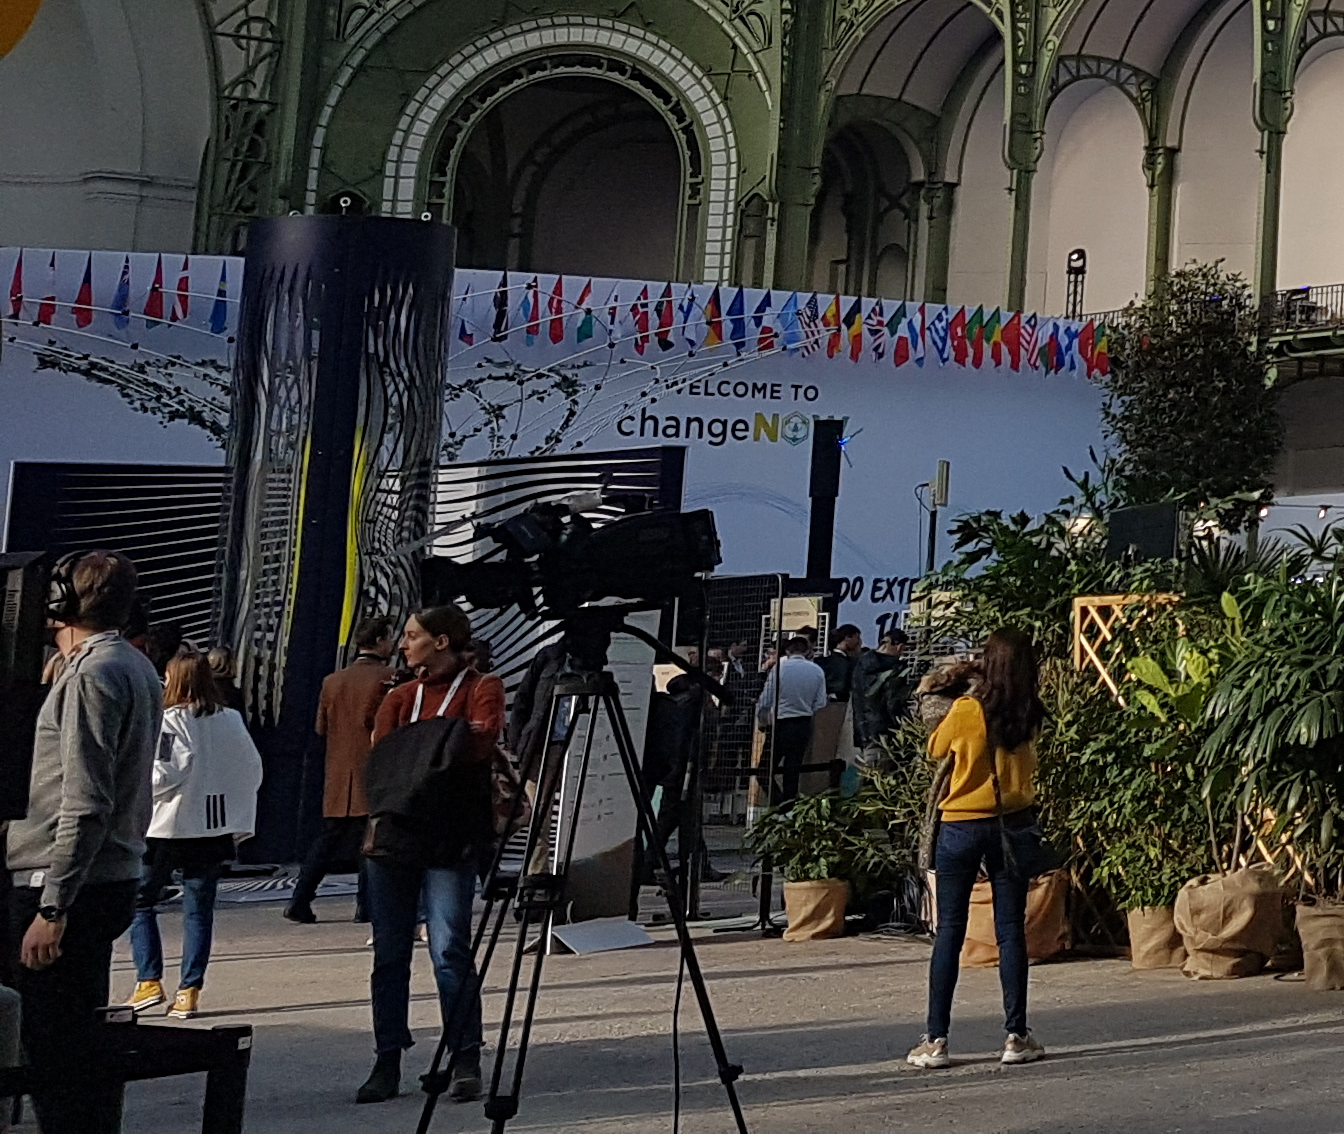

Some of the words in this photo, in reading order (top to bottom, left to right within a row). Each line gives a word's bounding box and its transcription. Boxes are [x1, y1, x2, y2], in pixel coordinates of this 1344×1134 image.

[663, 377, 782, 400] WELCOME
[790, 384, 819, 402] TO
[616, 407, 850, 447] changeNO
